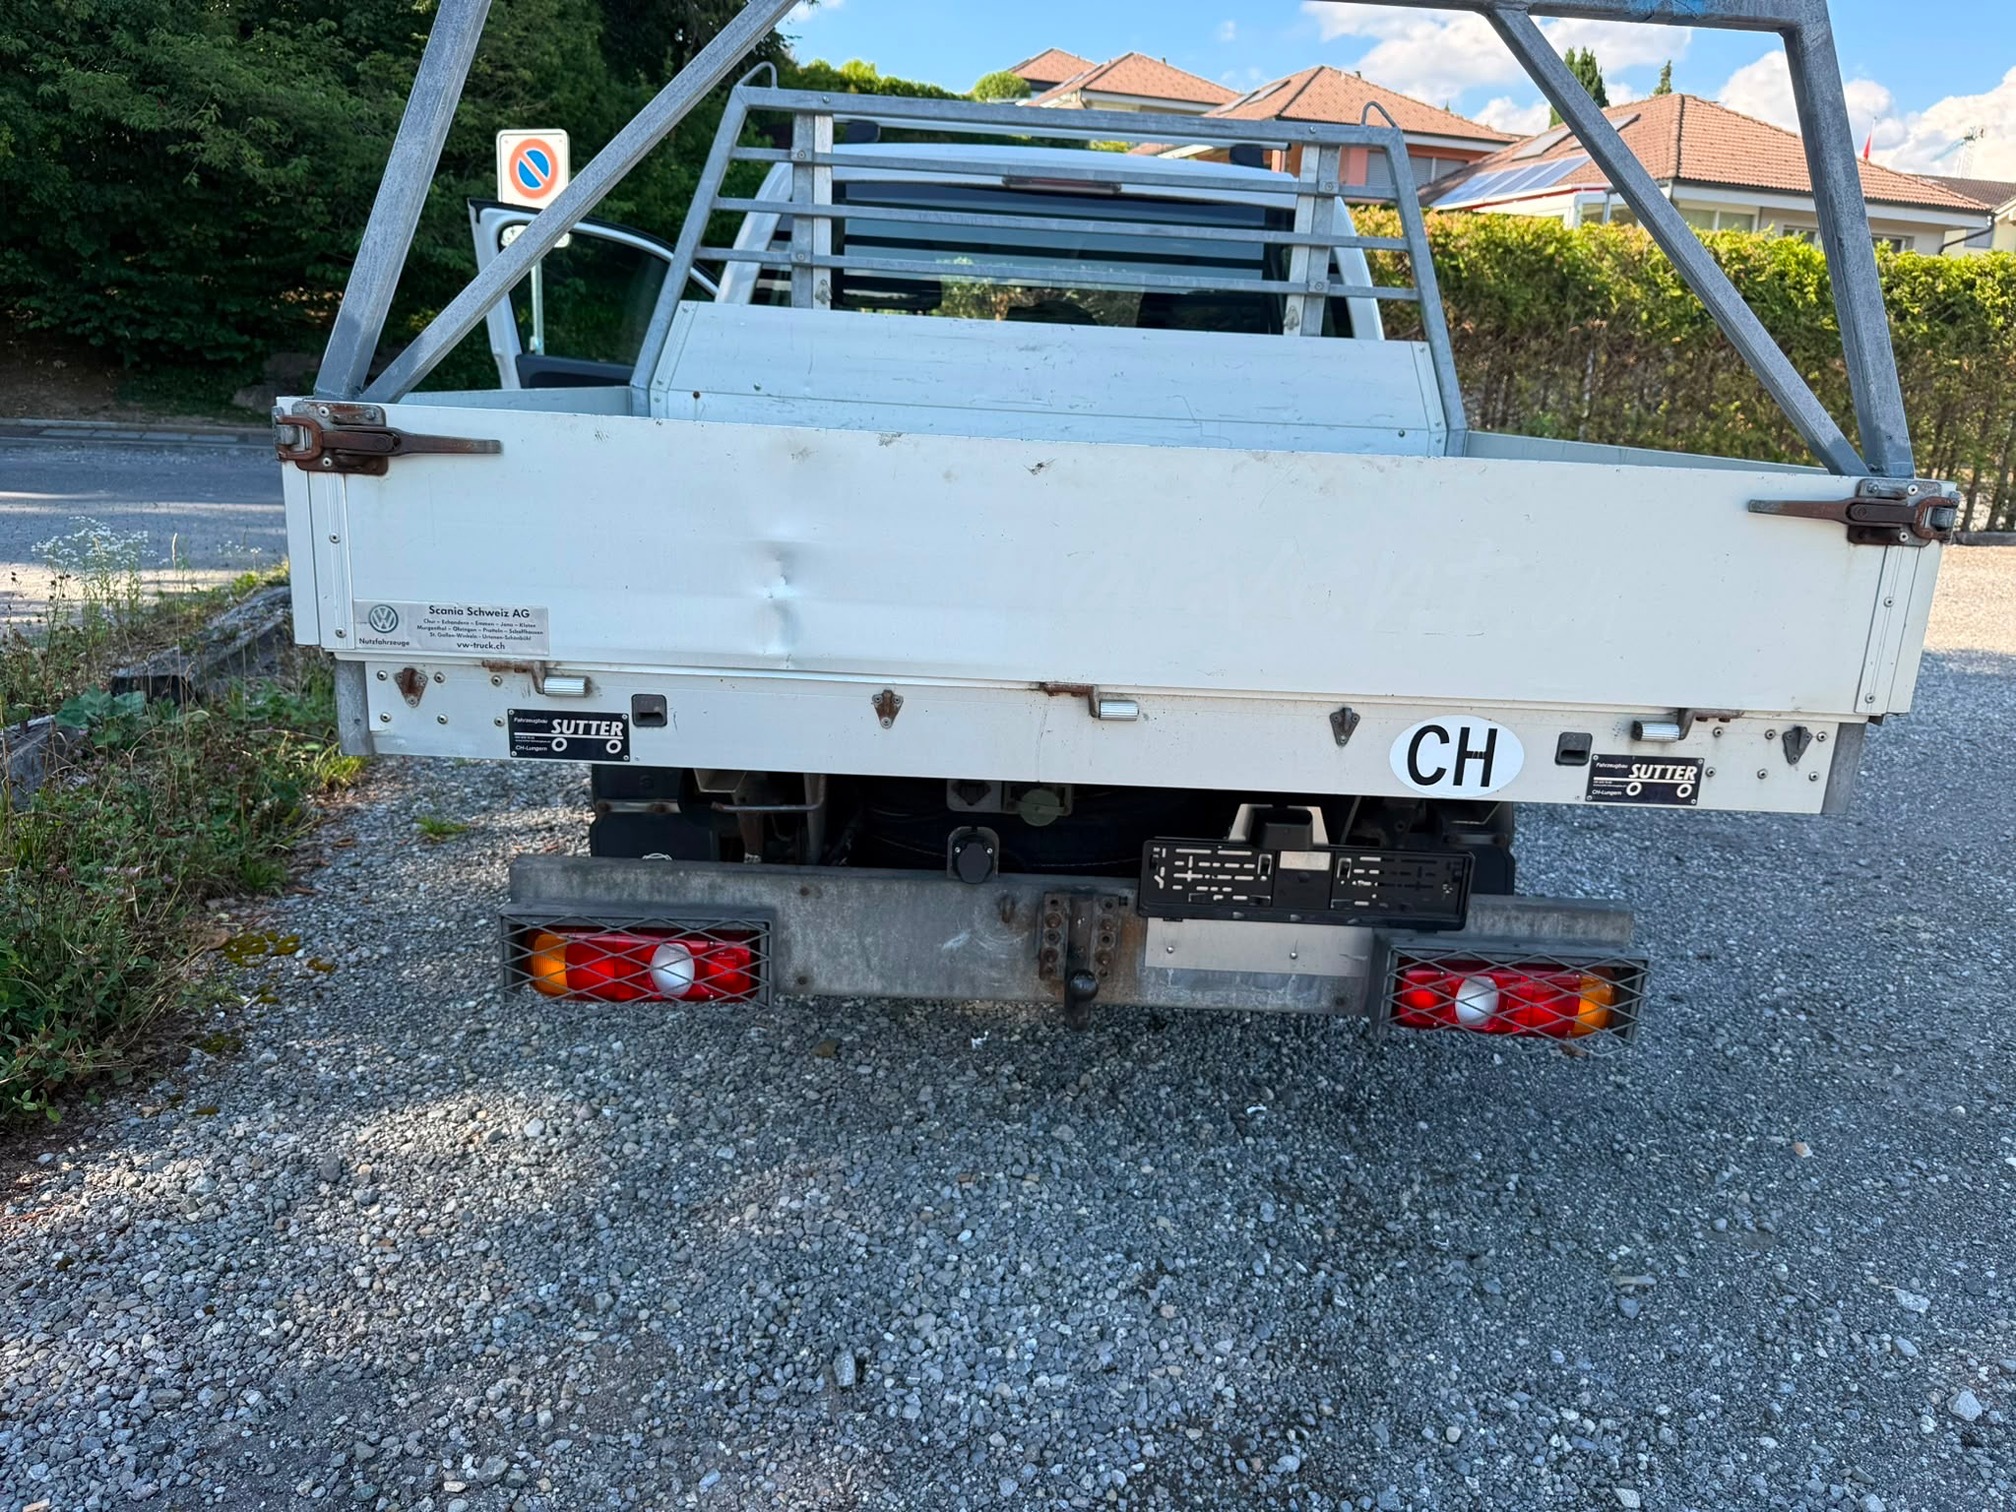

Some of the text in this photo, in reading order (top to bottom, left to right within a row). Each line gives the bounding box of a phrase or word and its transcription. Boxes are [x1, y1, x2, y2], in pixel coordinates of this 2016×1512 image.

[429, 605, 531, 619] Scania Schweiz AG
[359, 637, 411, 647] Nutzfahrzeuge
[456, 641, 506, 650] vw-truck.ch
[551, 718, 624, 736] SUTTER
[1407, 724, 1498, 788] CH
[1628, 763, 1698, 781] SUTTER
